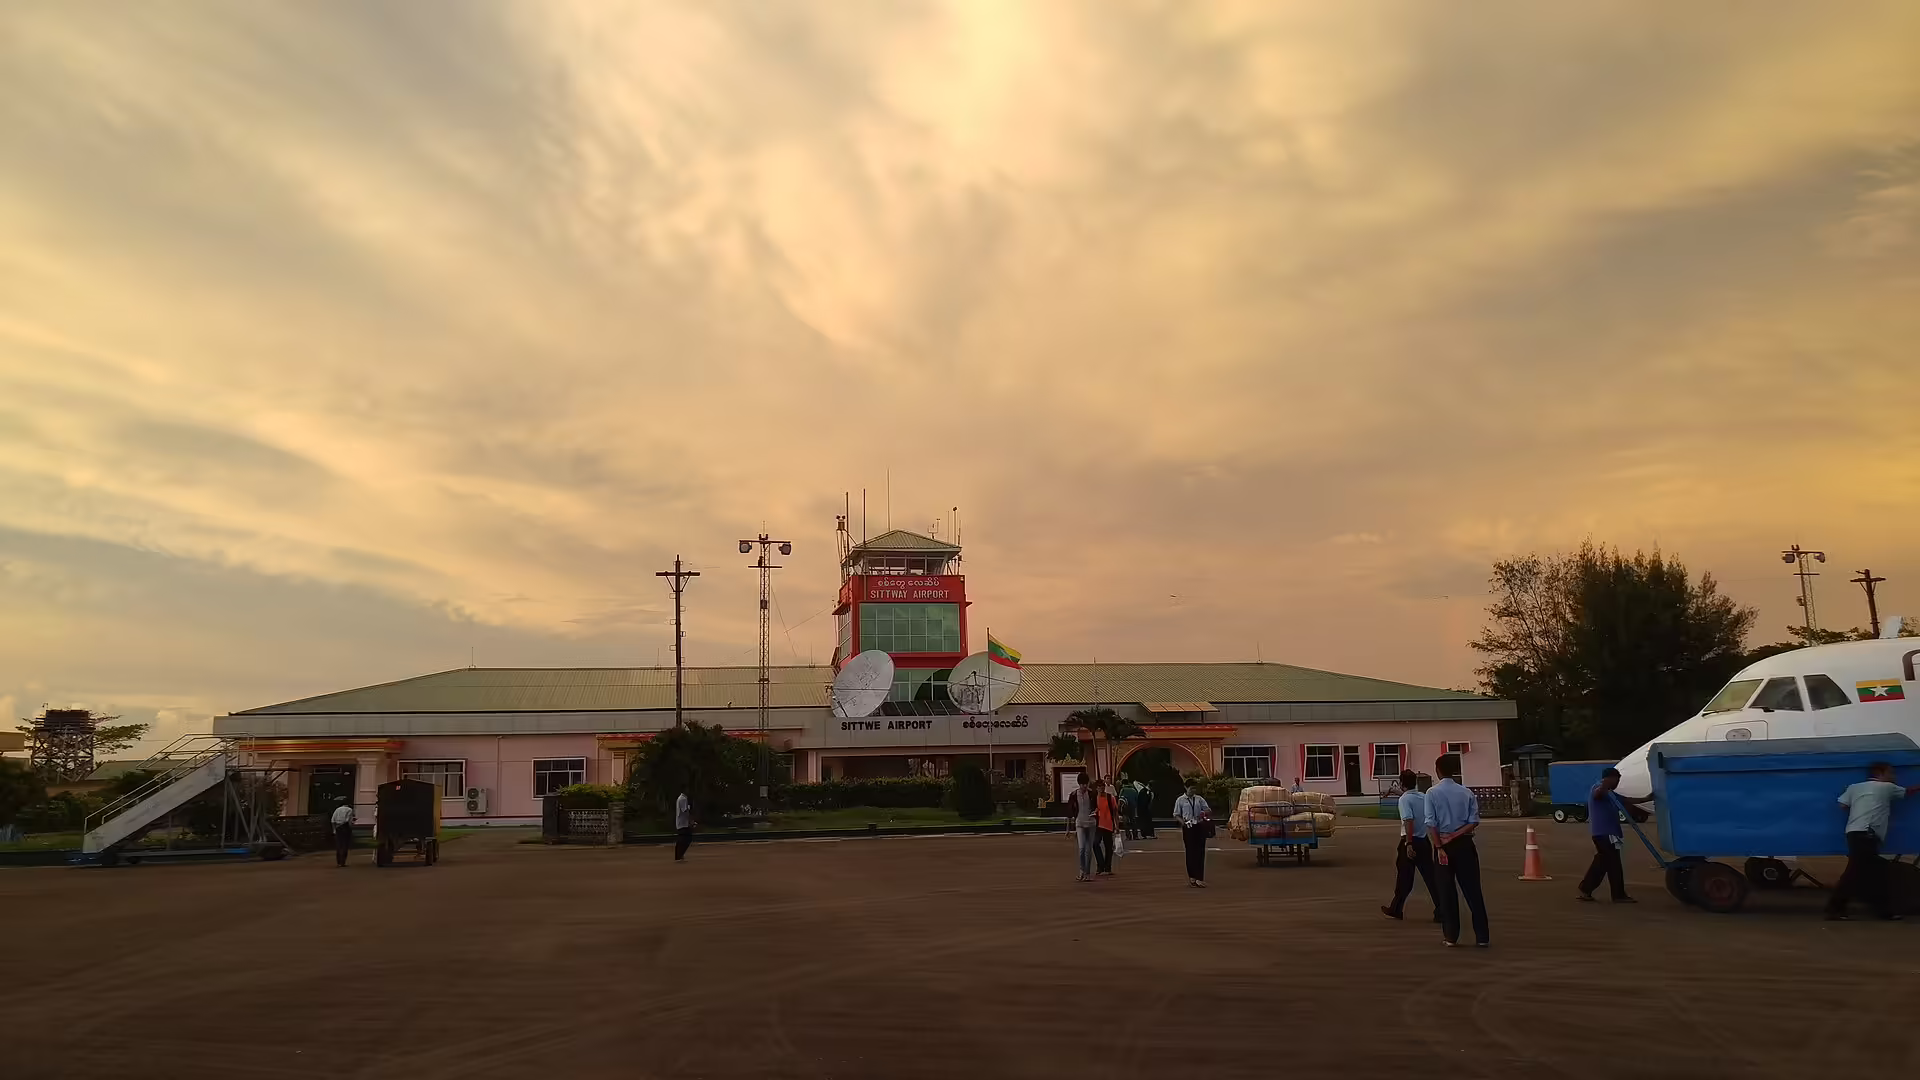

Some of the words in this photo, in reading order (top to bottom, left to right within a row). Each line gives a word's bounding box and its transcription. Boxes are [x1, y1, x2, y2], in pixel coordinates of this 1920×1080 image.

[870, 590, 908, 599] SITTWAY
[913, 590, 949, 599] AIRPORT
[841, 721, 880, 730] SITTWE
[888, 720, 932, 730] AIRPORT
